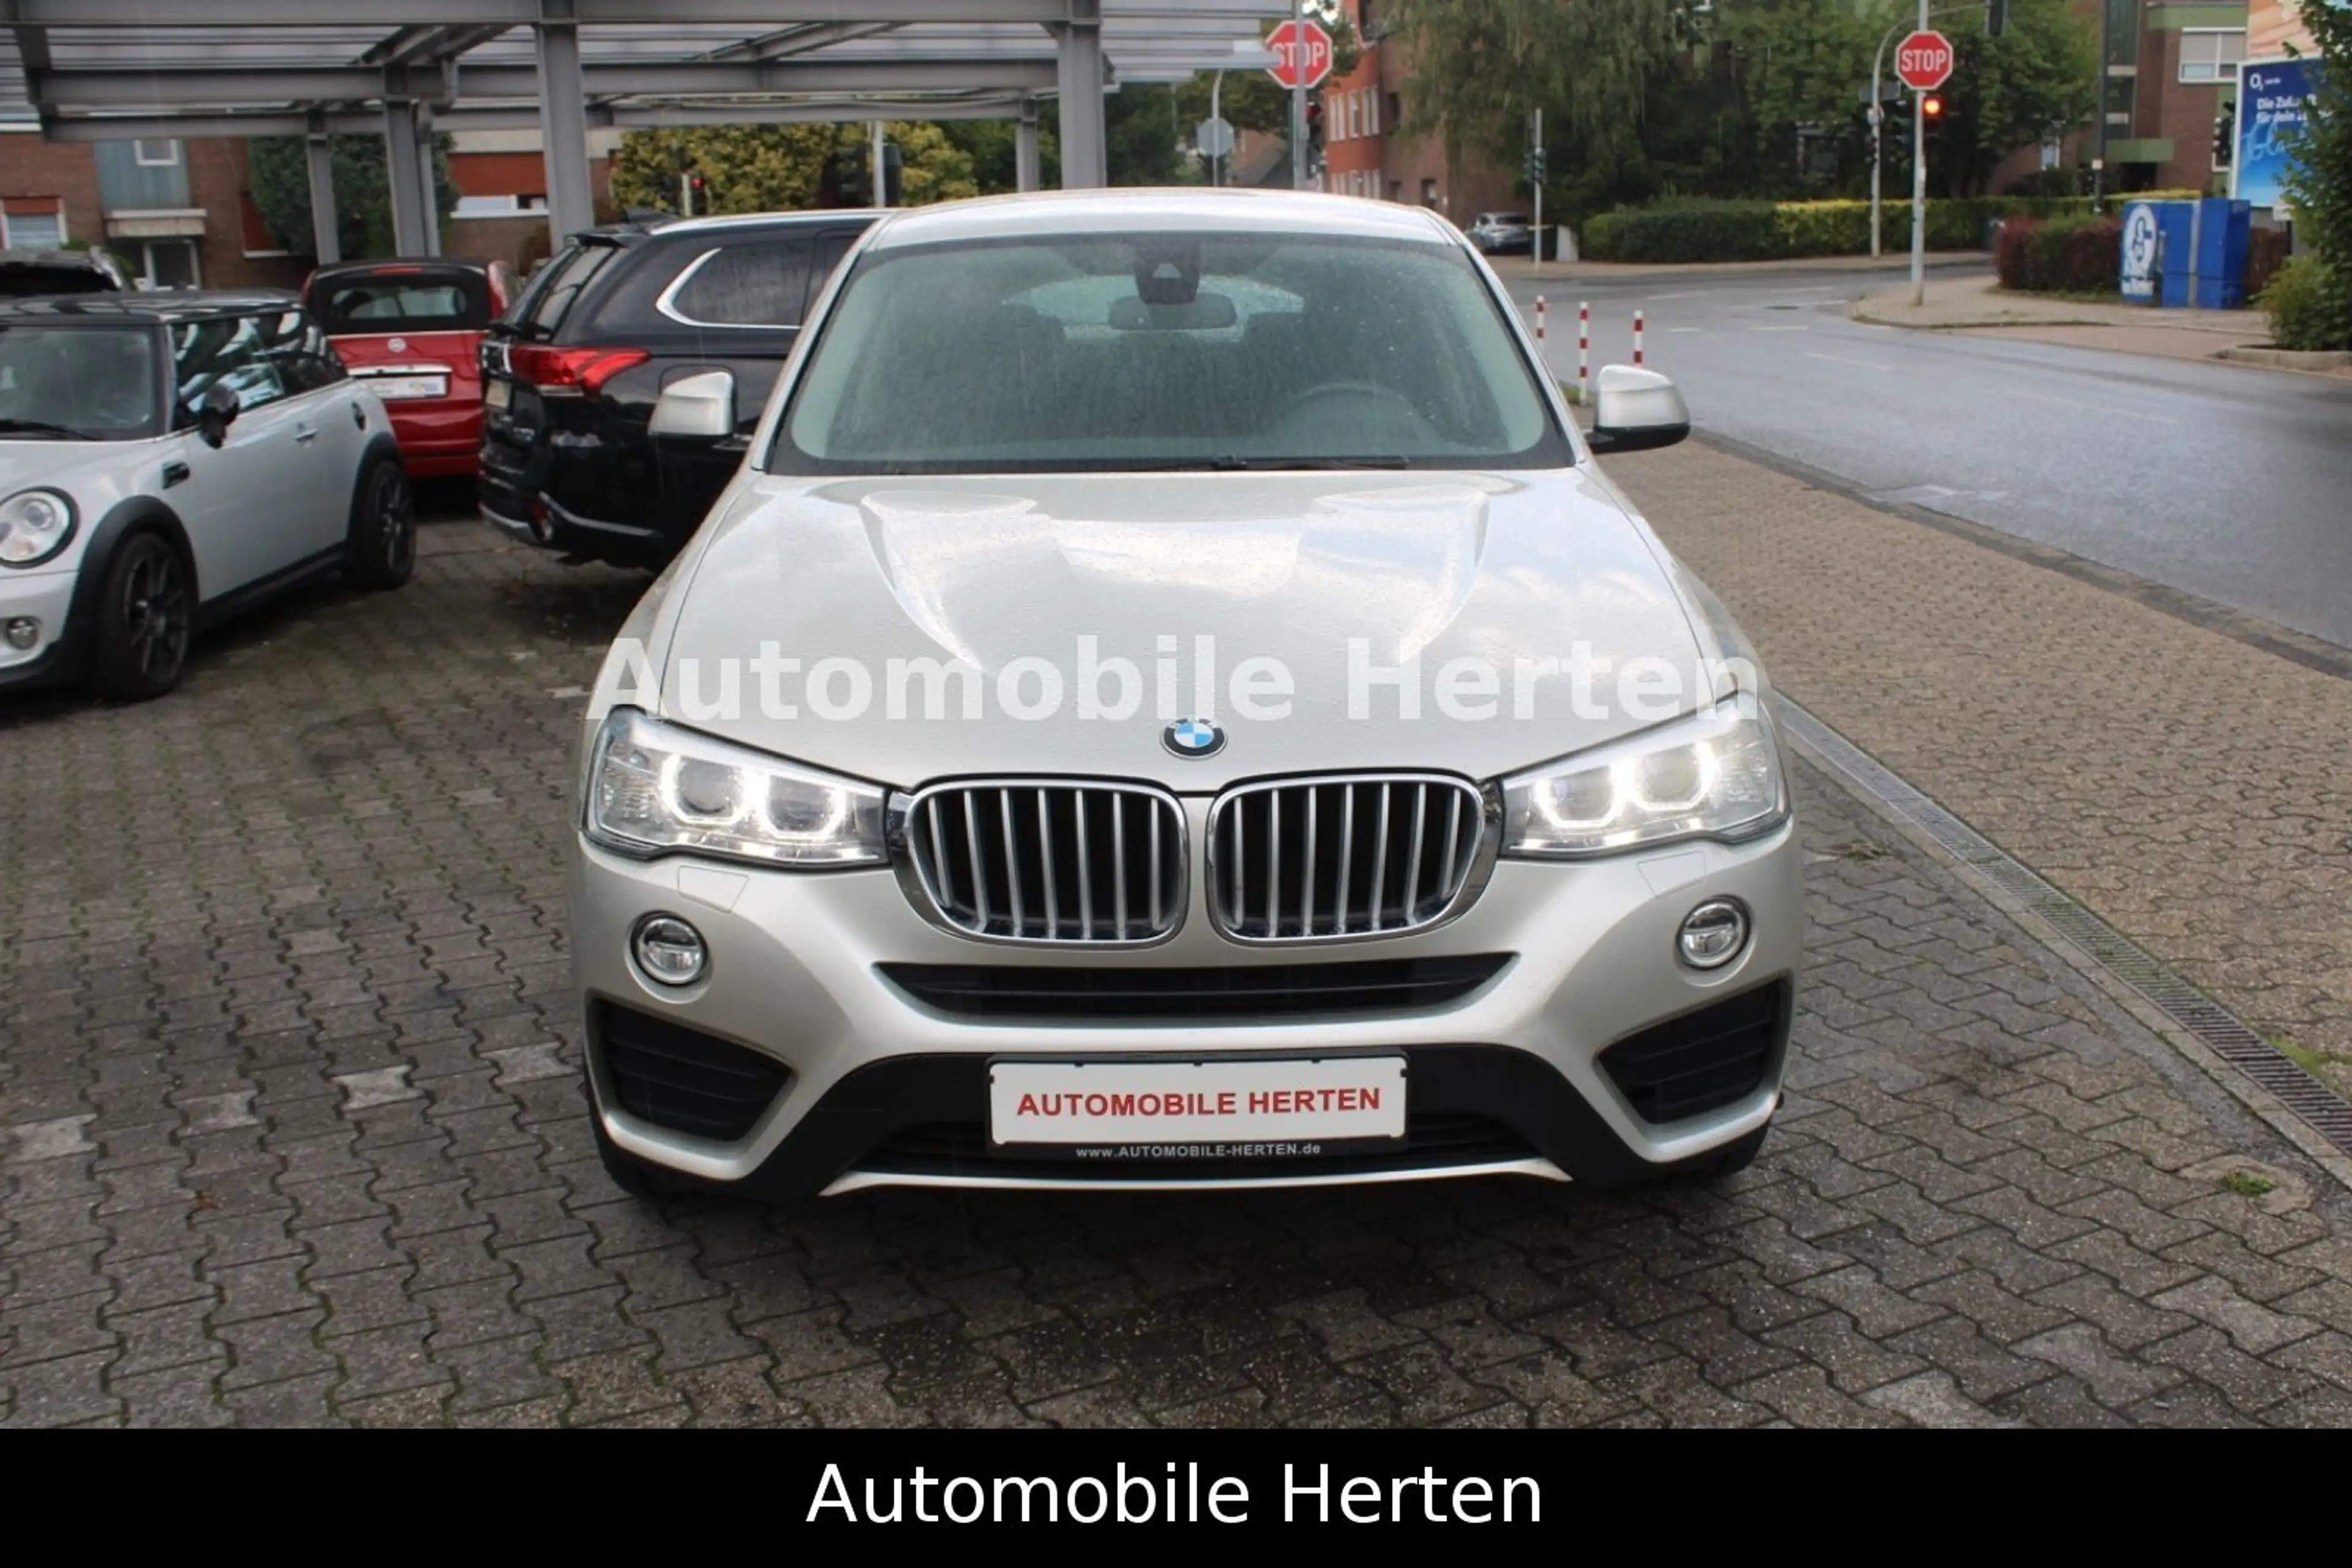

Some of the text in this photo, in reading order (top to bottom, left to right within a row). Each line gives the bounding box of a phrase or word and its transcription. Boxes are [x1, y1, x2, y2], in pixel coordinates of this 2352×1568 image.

[1901, 49, 1947, 72] STOP
[1017, 1087, 1381, 1117] AUTOMOBILE HERTEN
[1076, 1143, 1322, 1158] www.AUTOMOBILE-HERTEN.de
